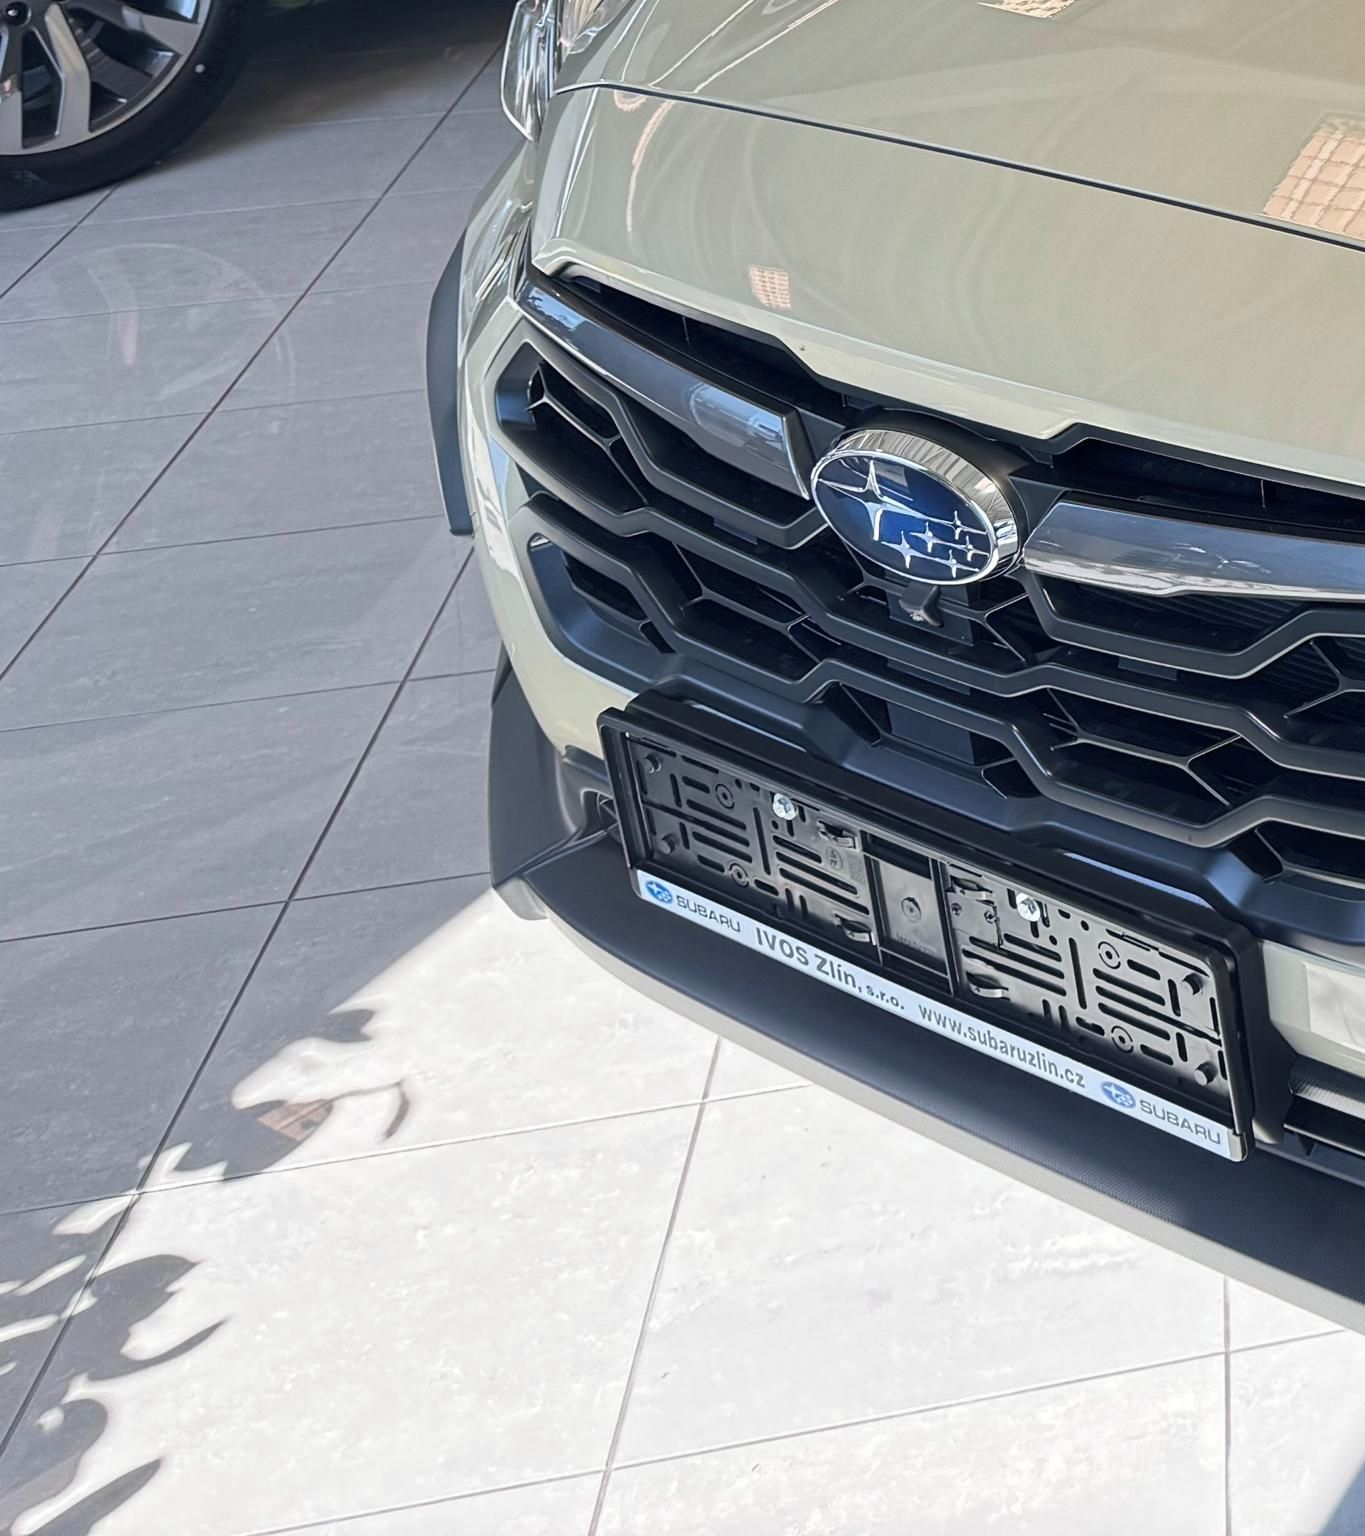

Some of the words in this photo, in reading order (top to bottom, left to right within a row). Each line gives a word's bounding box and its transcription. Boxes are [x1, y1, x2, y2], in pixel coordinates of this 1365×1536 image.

[675, 894, 741, 933] SUBARU
[755, 927, 809, 966] IVOS
[866, 984, 905, 1010] s.r.o.
[918, 1004, 1086, 1089] www.subaruzlin.cz
[1139, 1099, 1222, 1145] SUBARU
